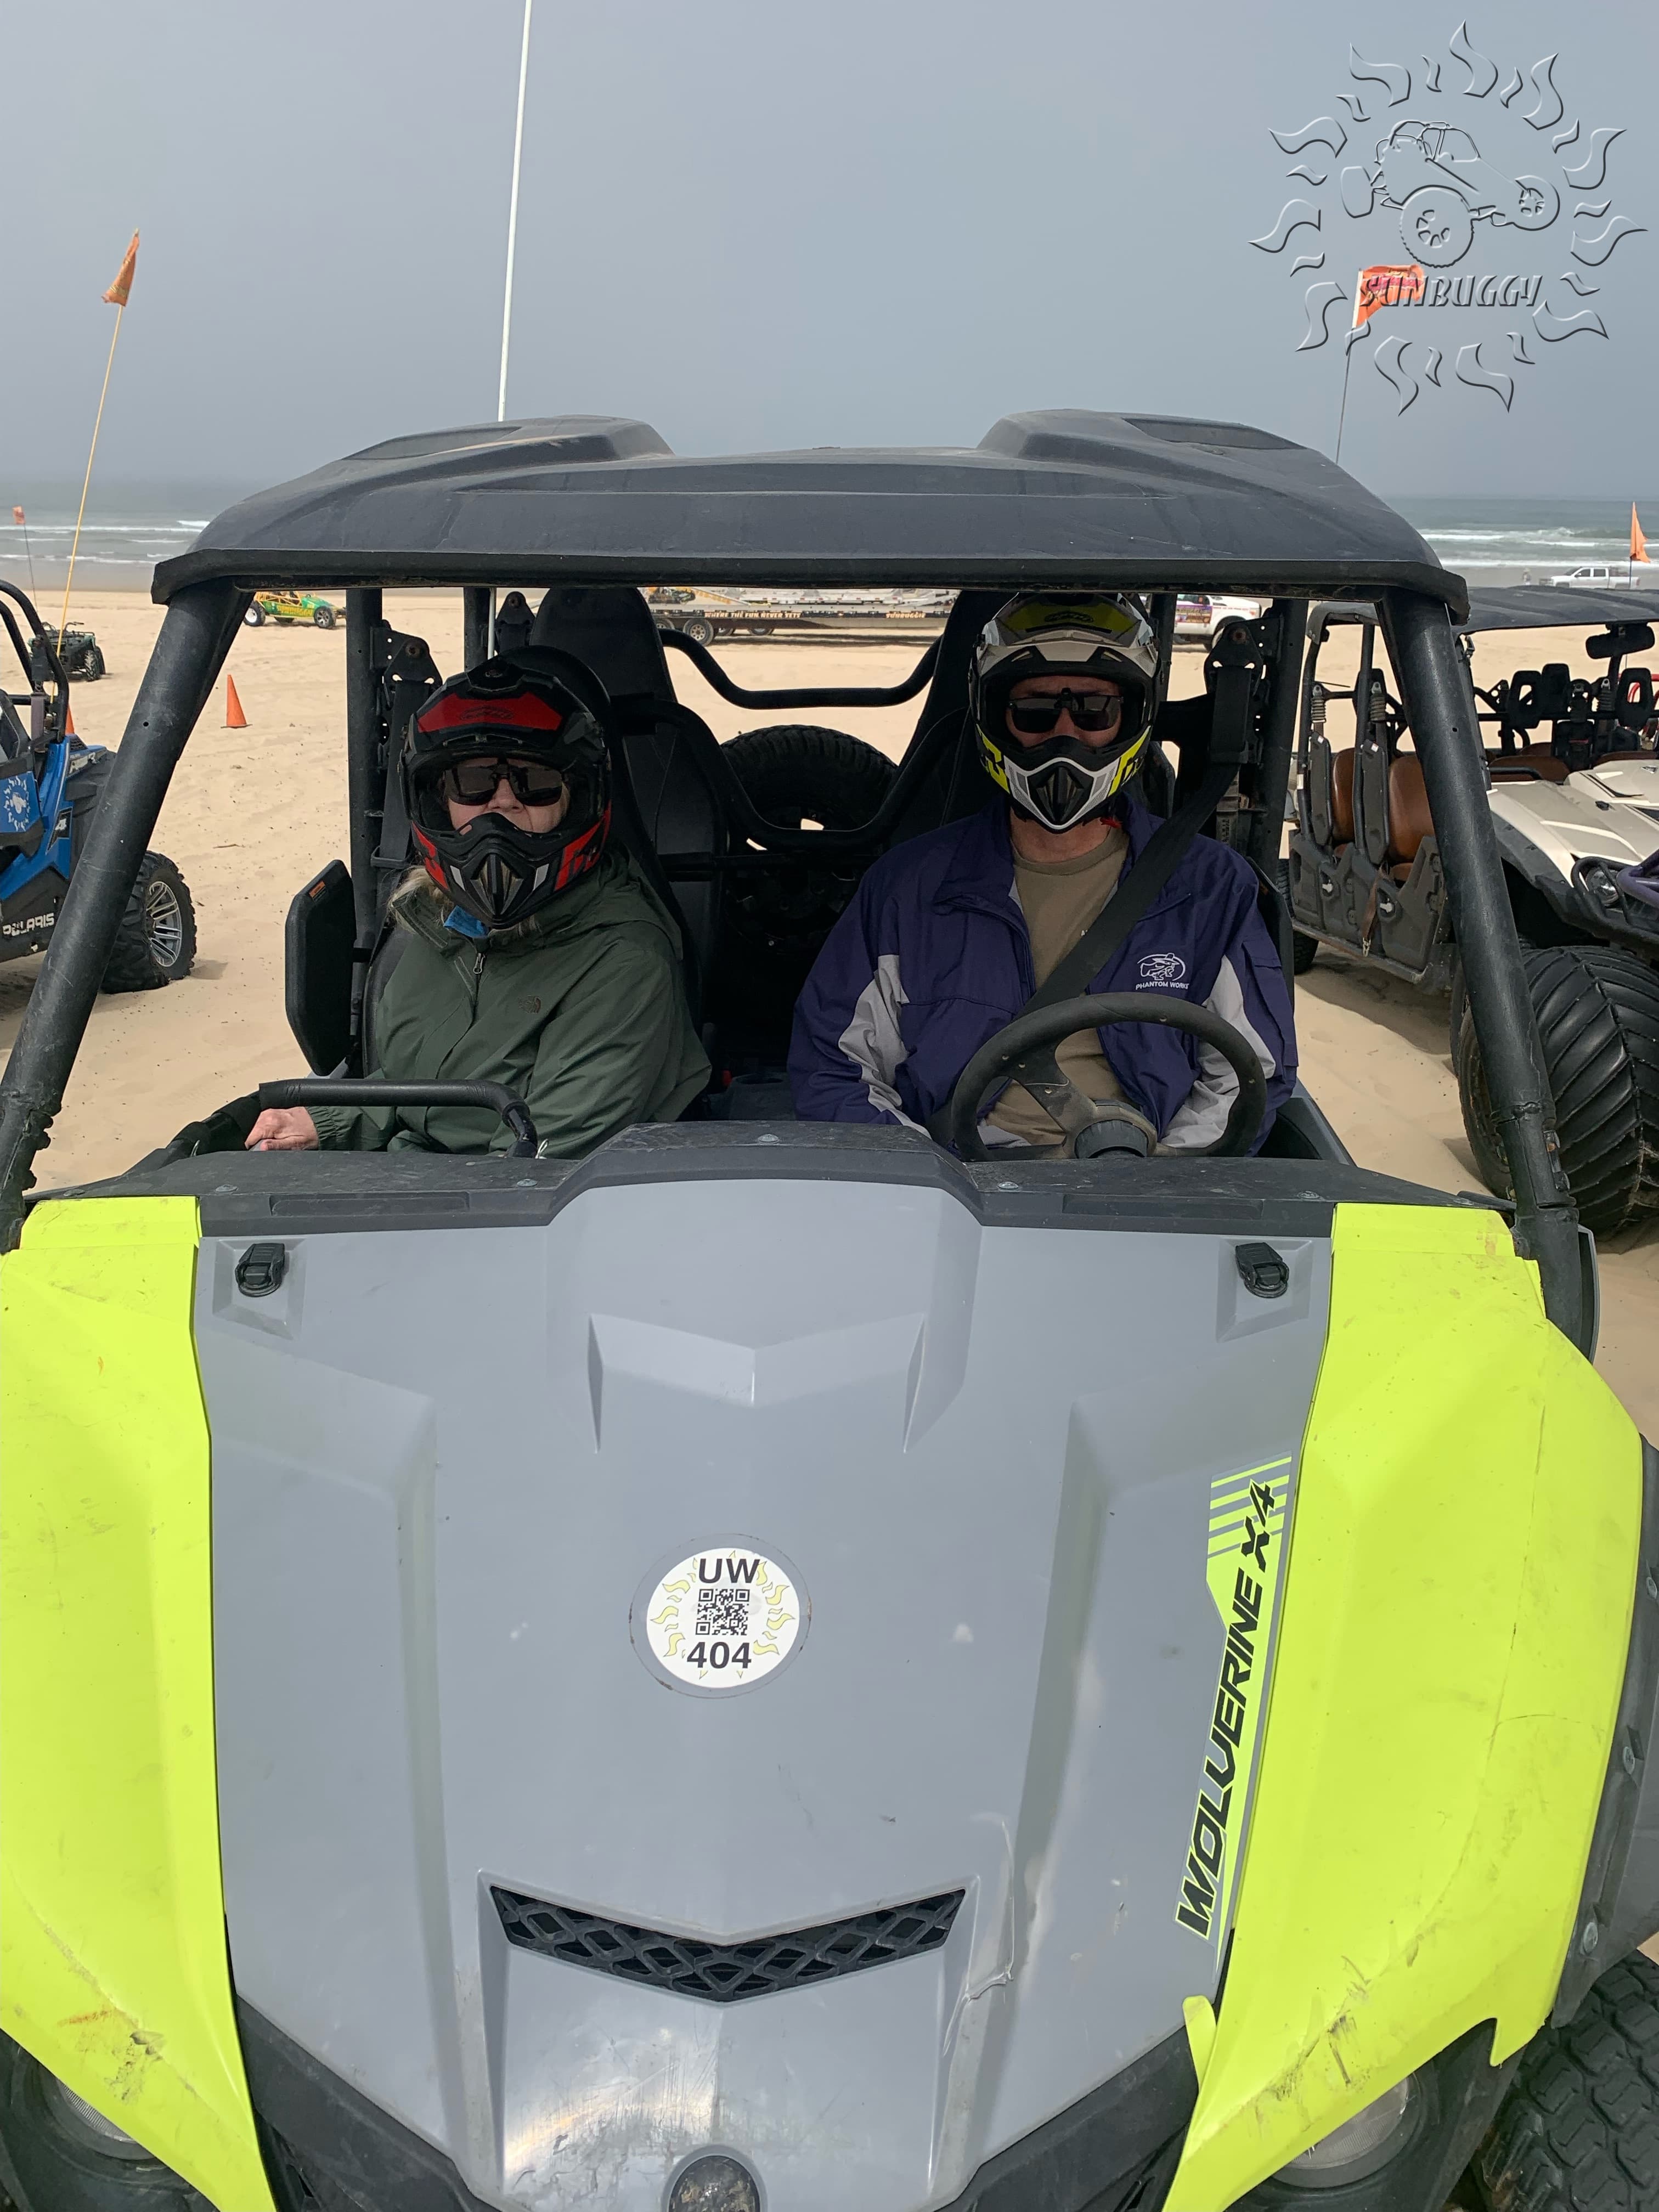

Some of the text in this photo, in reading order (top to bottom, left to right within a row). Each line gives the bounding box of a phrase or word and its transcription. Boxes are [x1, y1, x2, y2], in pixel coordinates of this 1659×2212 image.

[1135, 981, 1169, 990] PHANTOM
[698, 1558, 760, 1584] UW
[686, 1641, 752, 1669] 404
[1177, 1481, 1275, 1938] WOLVERINE X4
